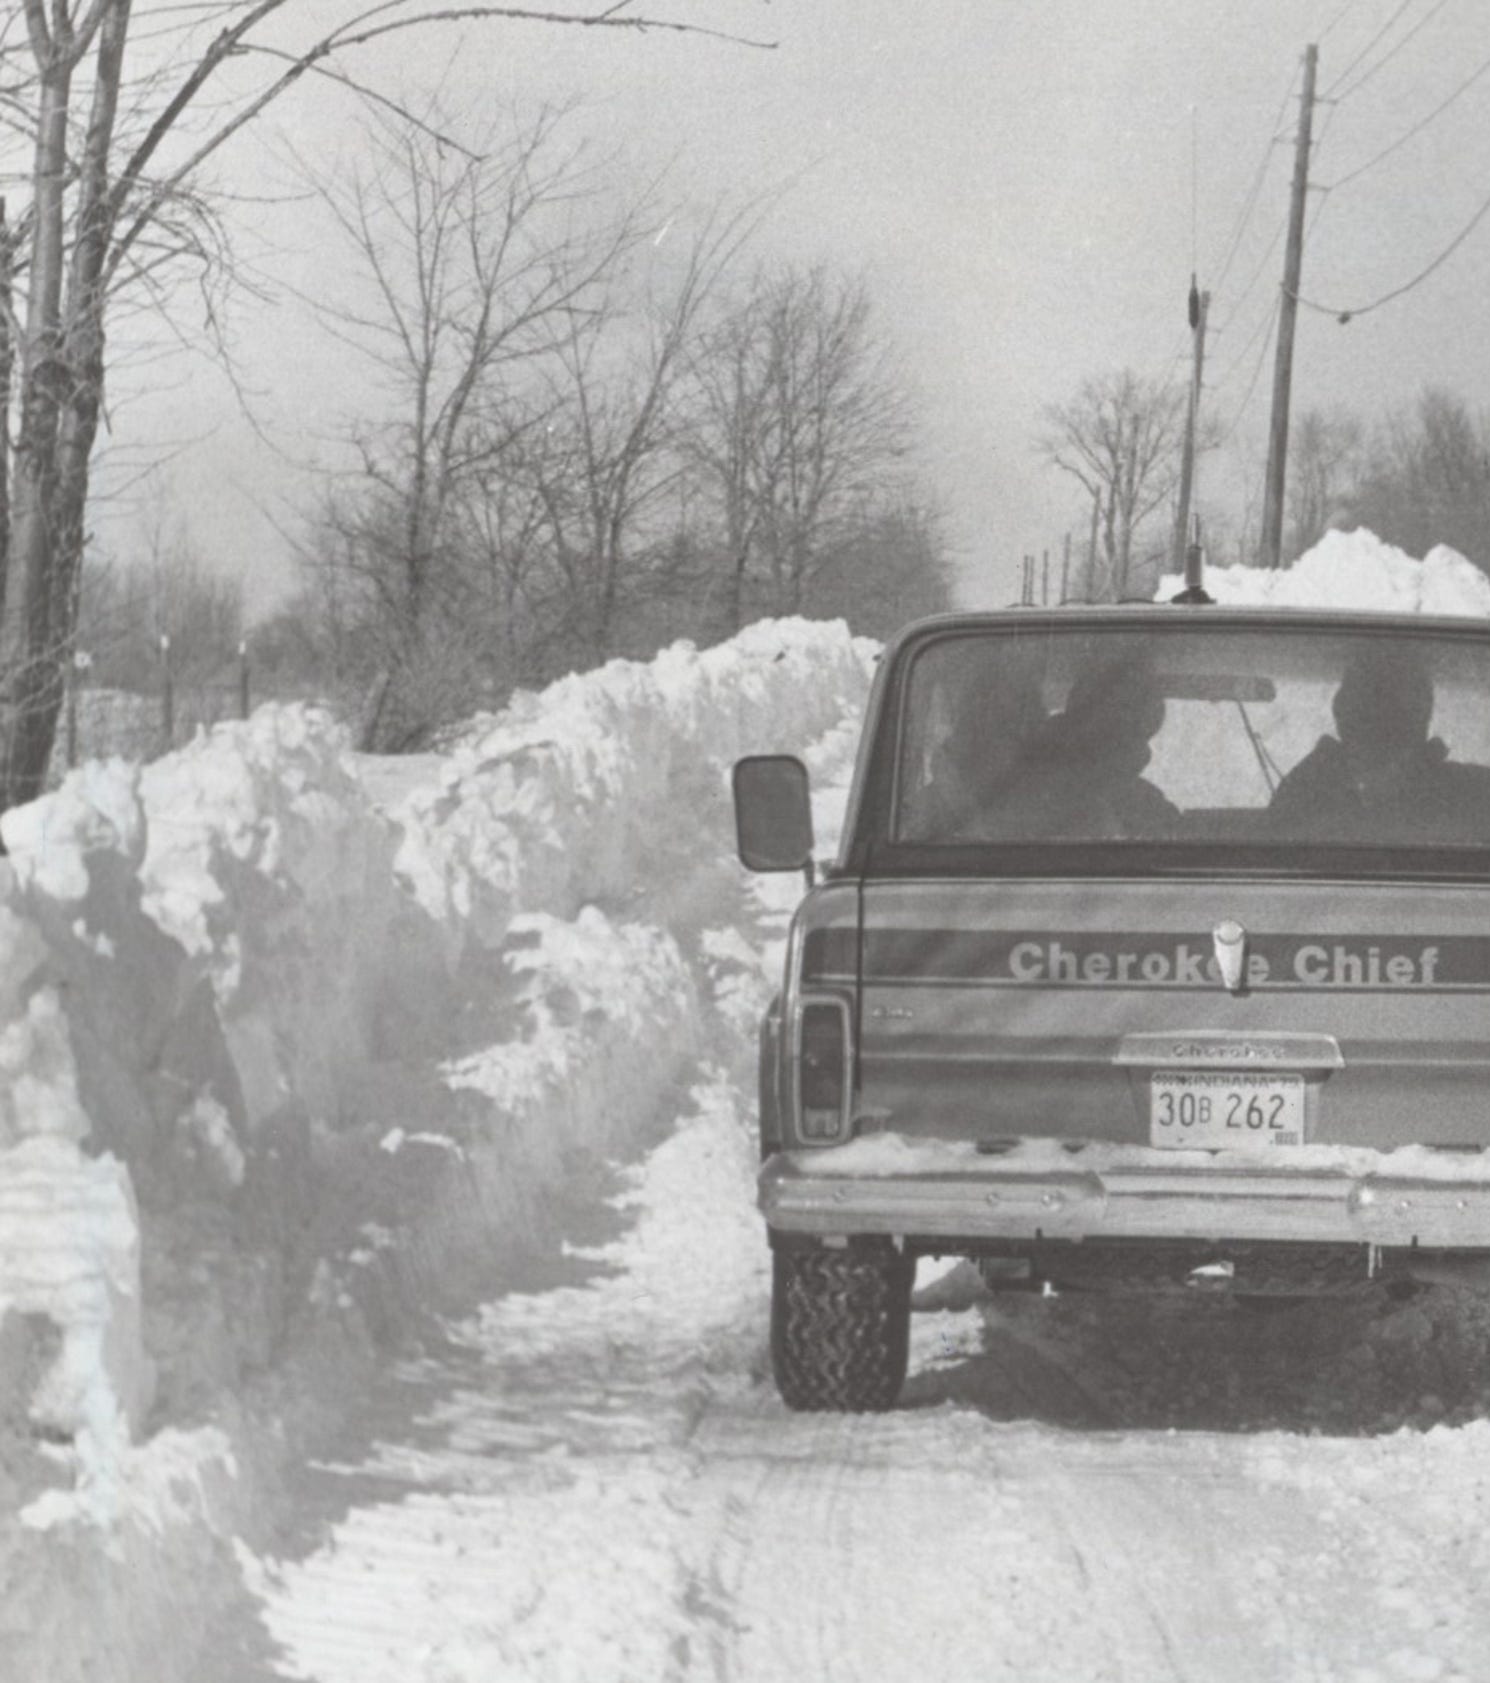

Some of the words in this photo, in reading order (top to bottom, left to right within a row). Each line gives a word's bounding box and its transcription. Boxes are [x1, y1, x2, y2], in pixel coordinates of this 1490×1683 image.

[1294, 944, 1439, 985] Chief
[1193, 1074, 1270, 1088] INDIANA
[1158, 1092, 1212, 1127] 30B
[1226, 1093, 1285, 1130] 262
